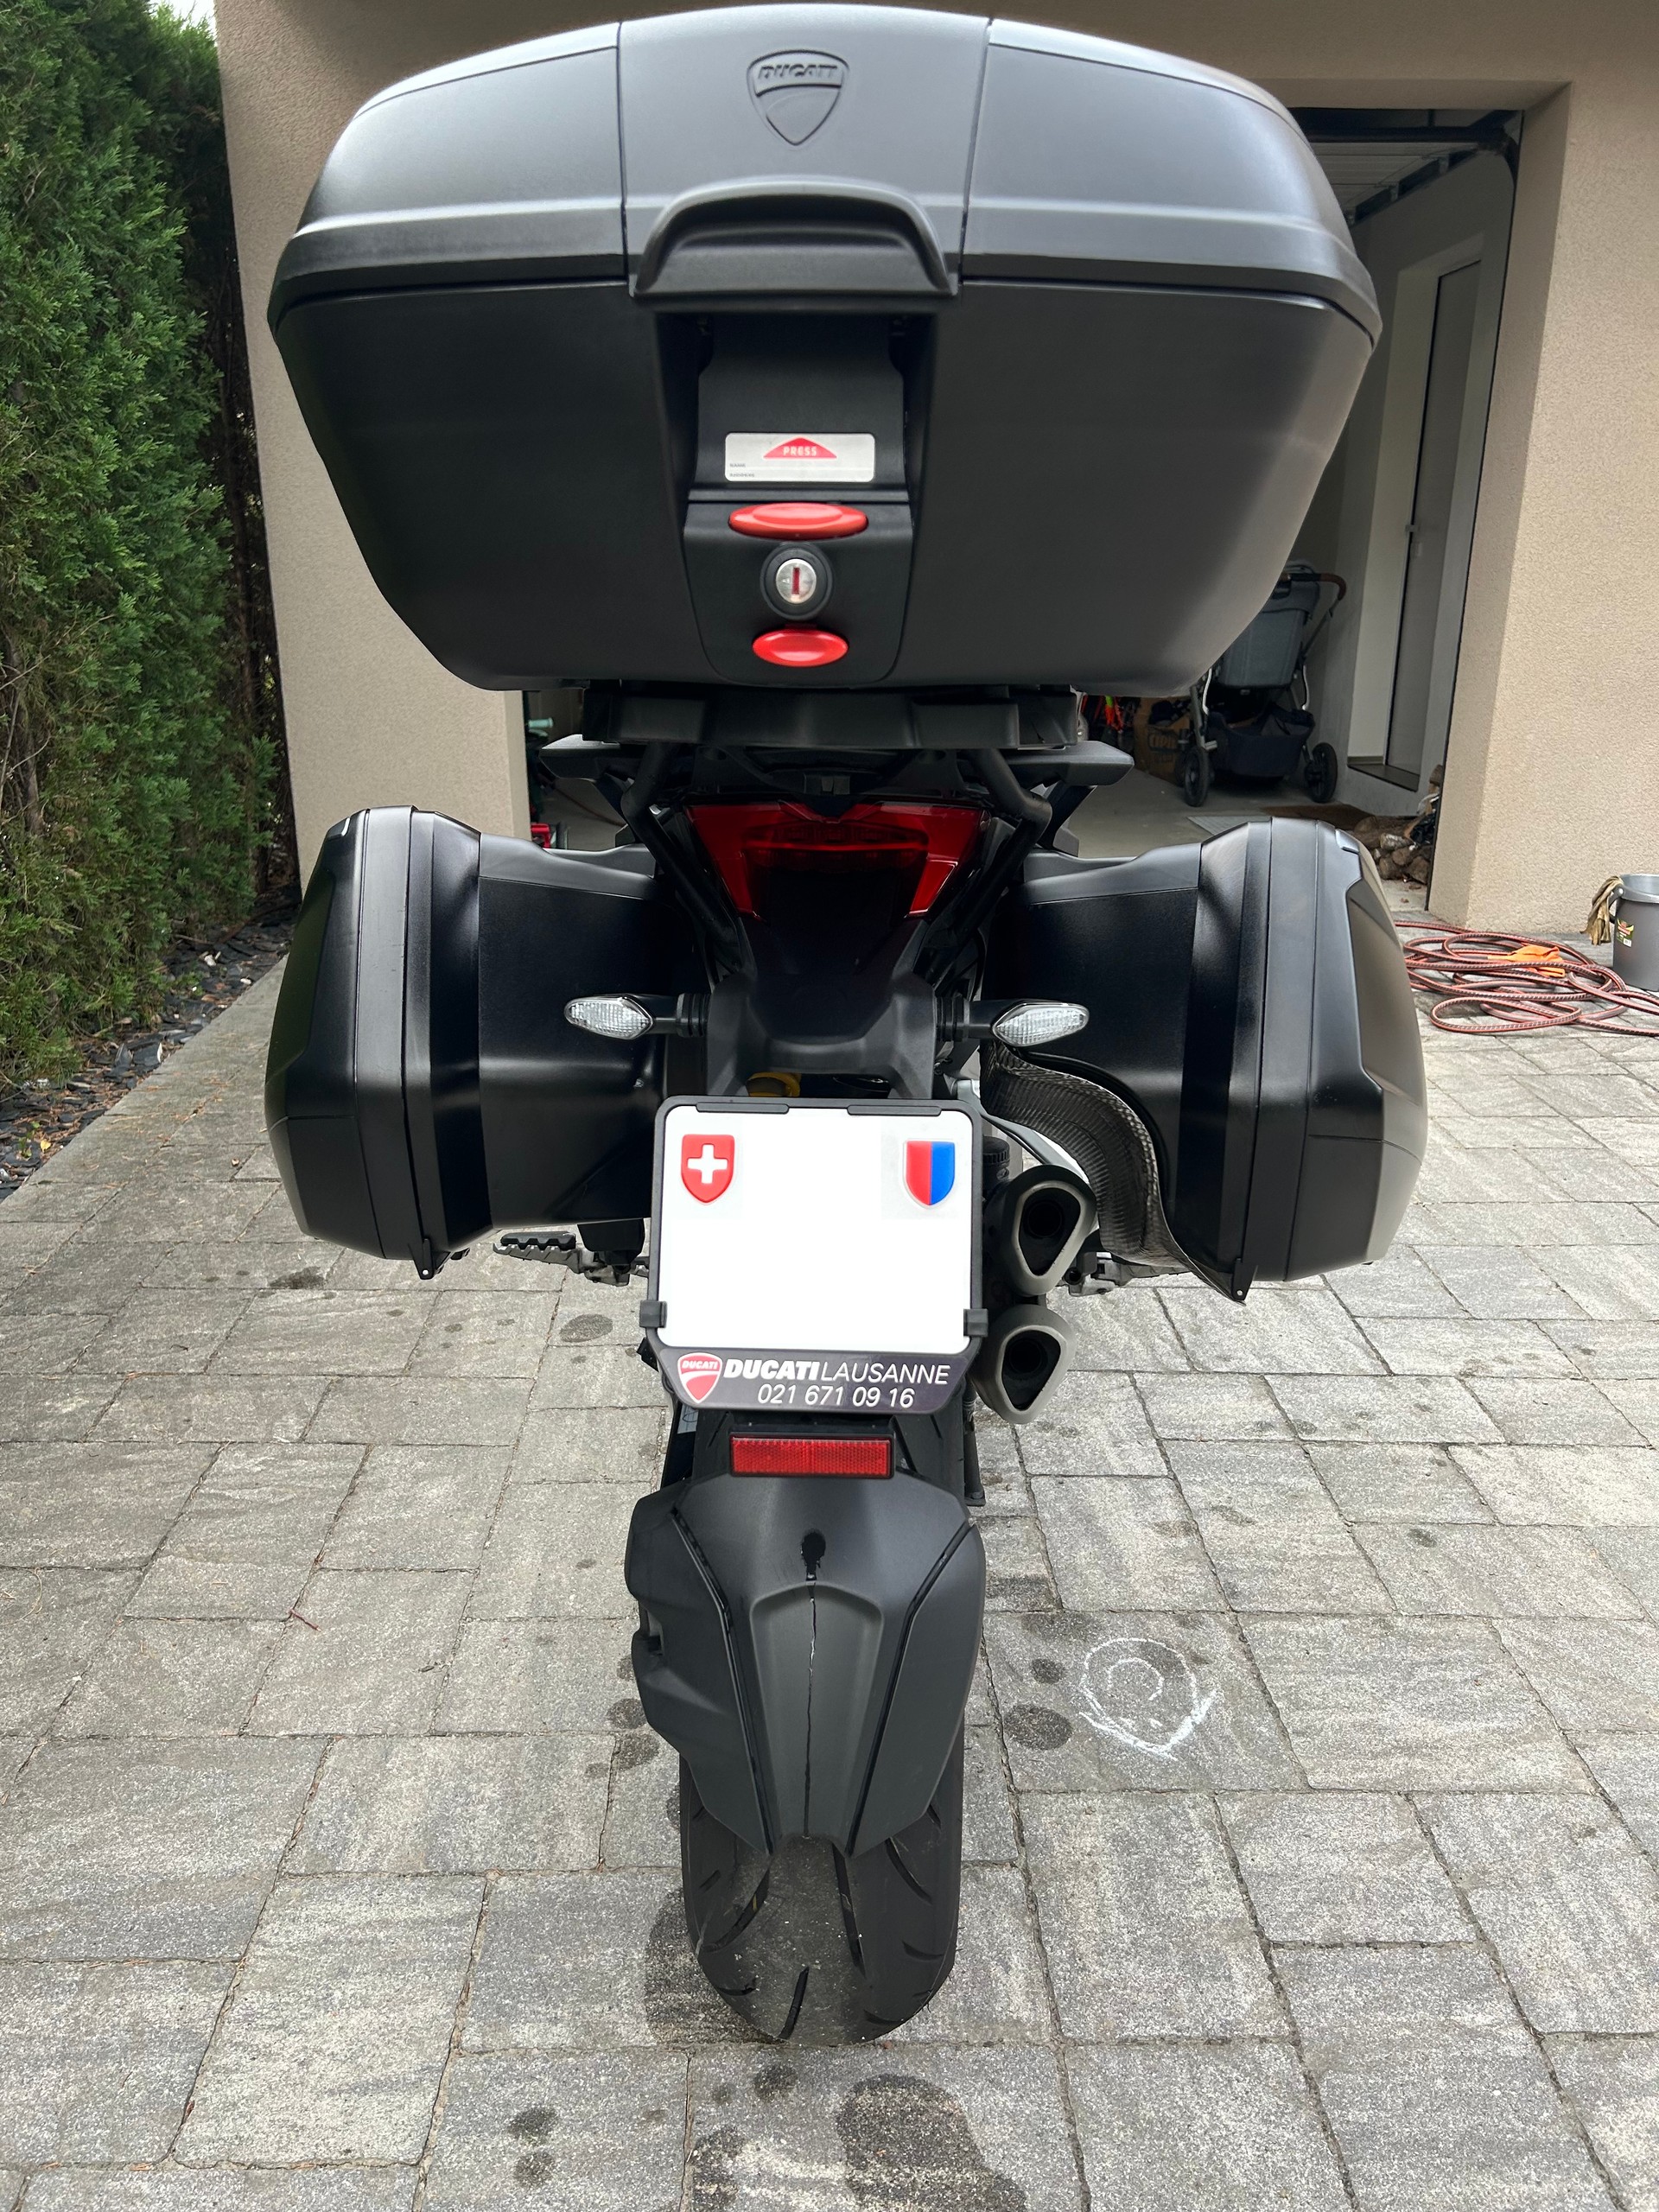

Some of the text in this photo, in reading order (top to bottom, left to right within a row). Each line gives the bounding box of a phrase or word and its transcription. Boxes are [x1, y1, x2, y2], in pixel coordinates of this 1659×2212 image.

[758, 63, 838, 79] DUCATI
[783, 446, 817, 456] PRESS
[682, 1360, 718, 1370] DUCATI
[723, 1359, 950, 1385] DUCATI LAUSANNE
[758, 1383, 915, 1408] 021 671 09 16
